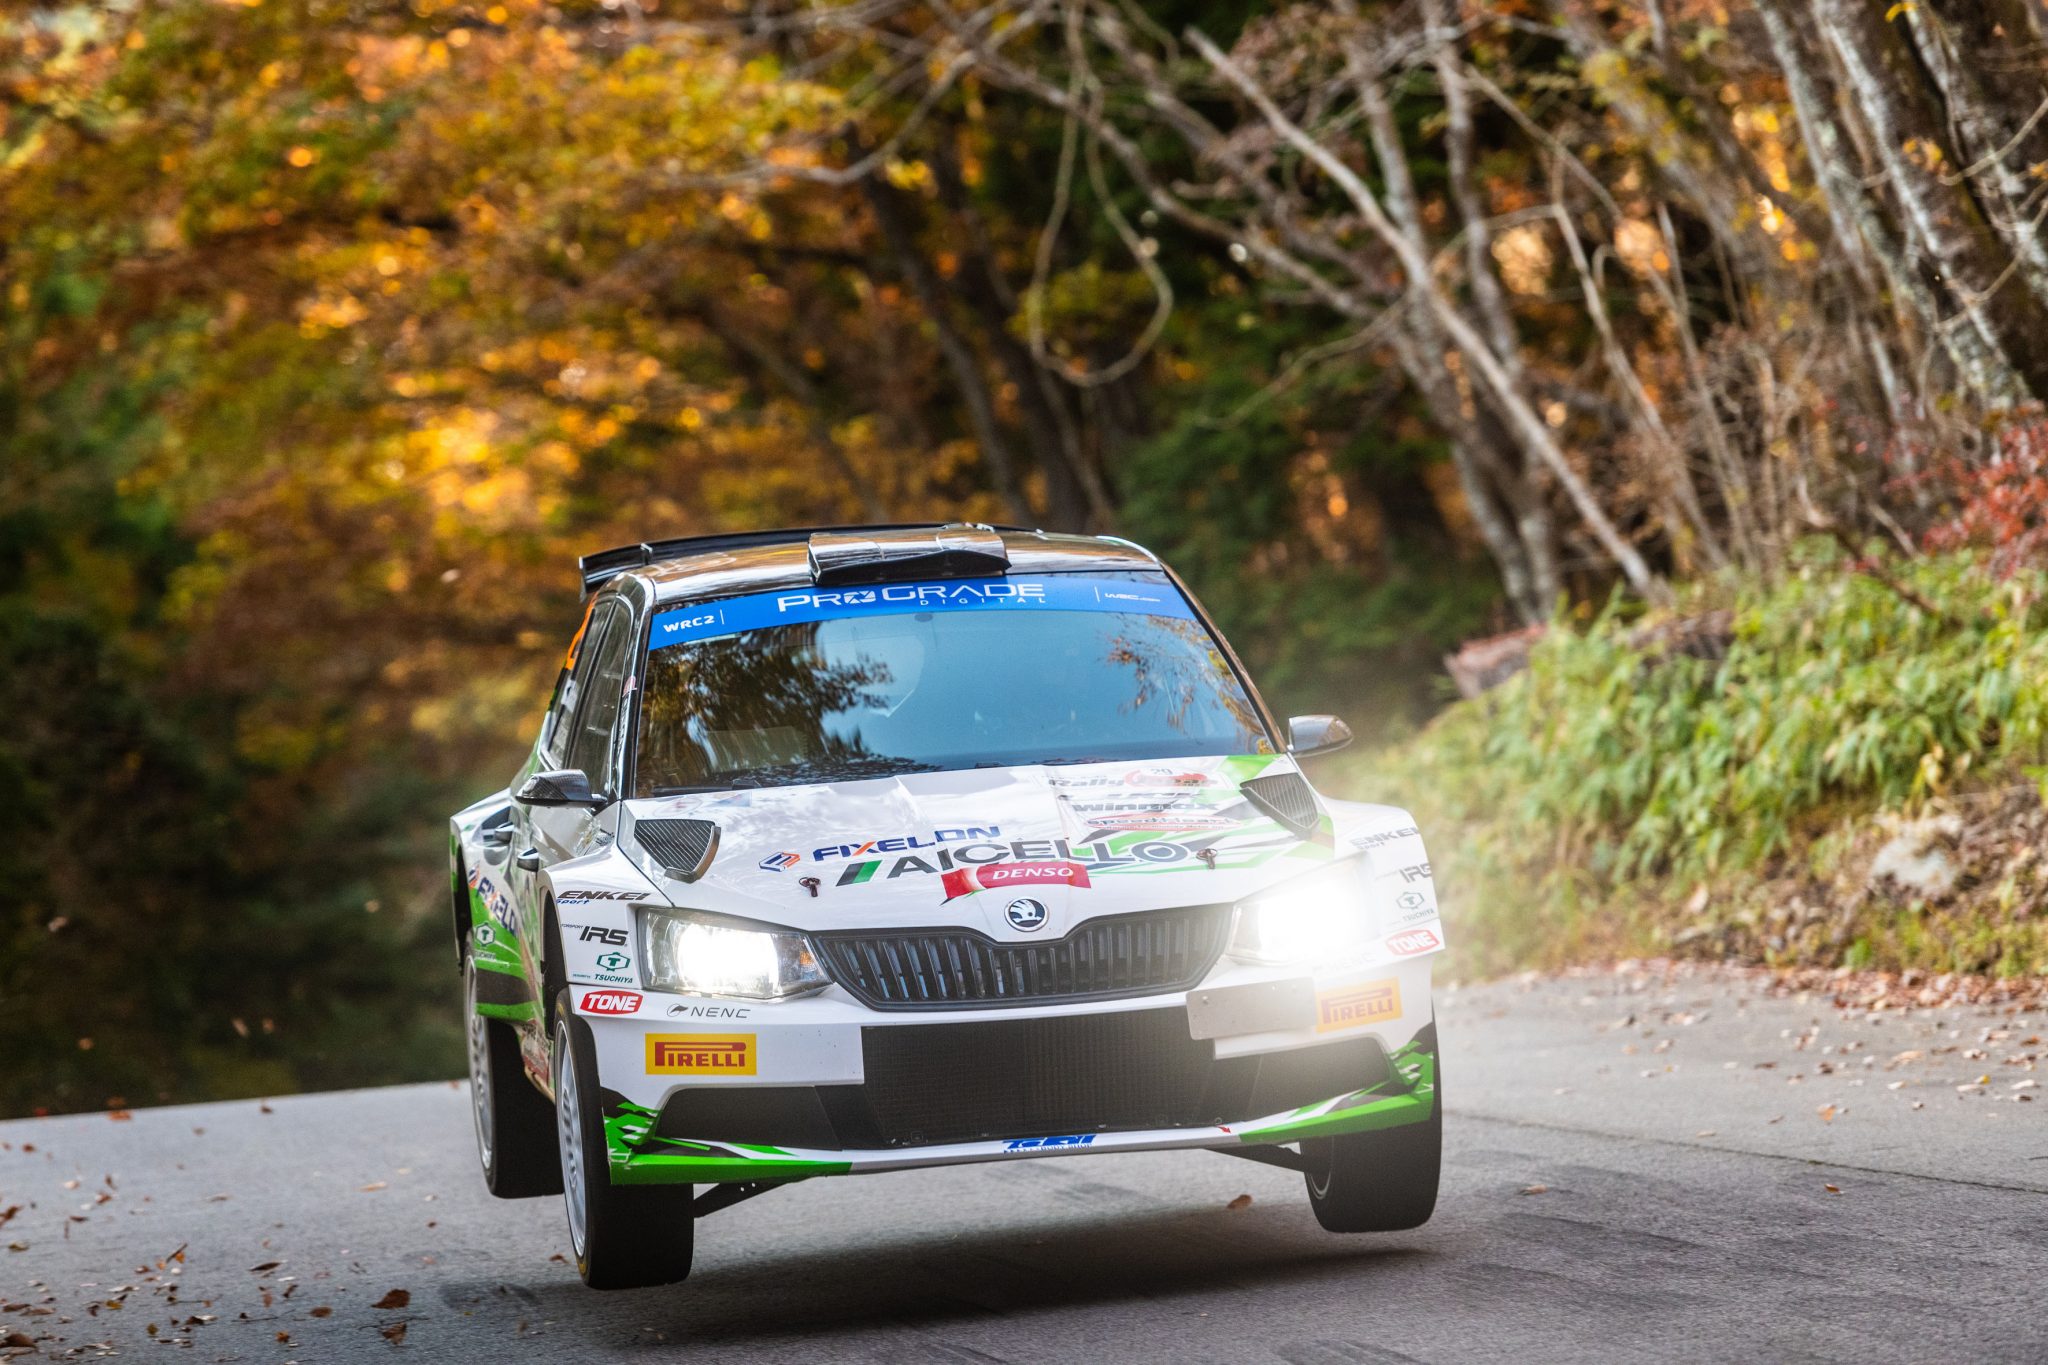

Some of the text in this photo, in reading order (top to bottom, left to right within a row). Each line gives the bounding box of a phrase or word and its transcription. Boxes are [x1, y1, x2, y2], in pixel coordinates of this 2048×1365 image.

[777, 583, 1046, 613] PROGRADE
[920, 597, 1046, 606] DIGITAL
[663, 614, 715, 633] WRC2
[812, 825, 1001, 862] FIXELON
[886, 838, 1190, 880] AICELLO
[992, 866, 1074, 881] DENSO
[557, 890, 651, 901] ENKEI
[579, 926, 629, 947] IRS
[594, 973, 634, 984] TSUCHIYA
[588, 994, 638, 1012] TONE
[690, 1006, 752, 1019] NENC
[1320, 986, 1394, 1025] PIRELLI
[654, 1041, 748, 1068] PIRELLI
